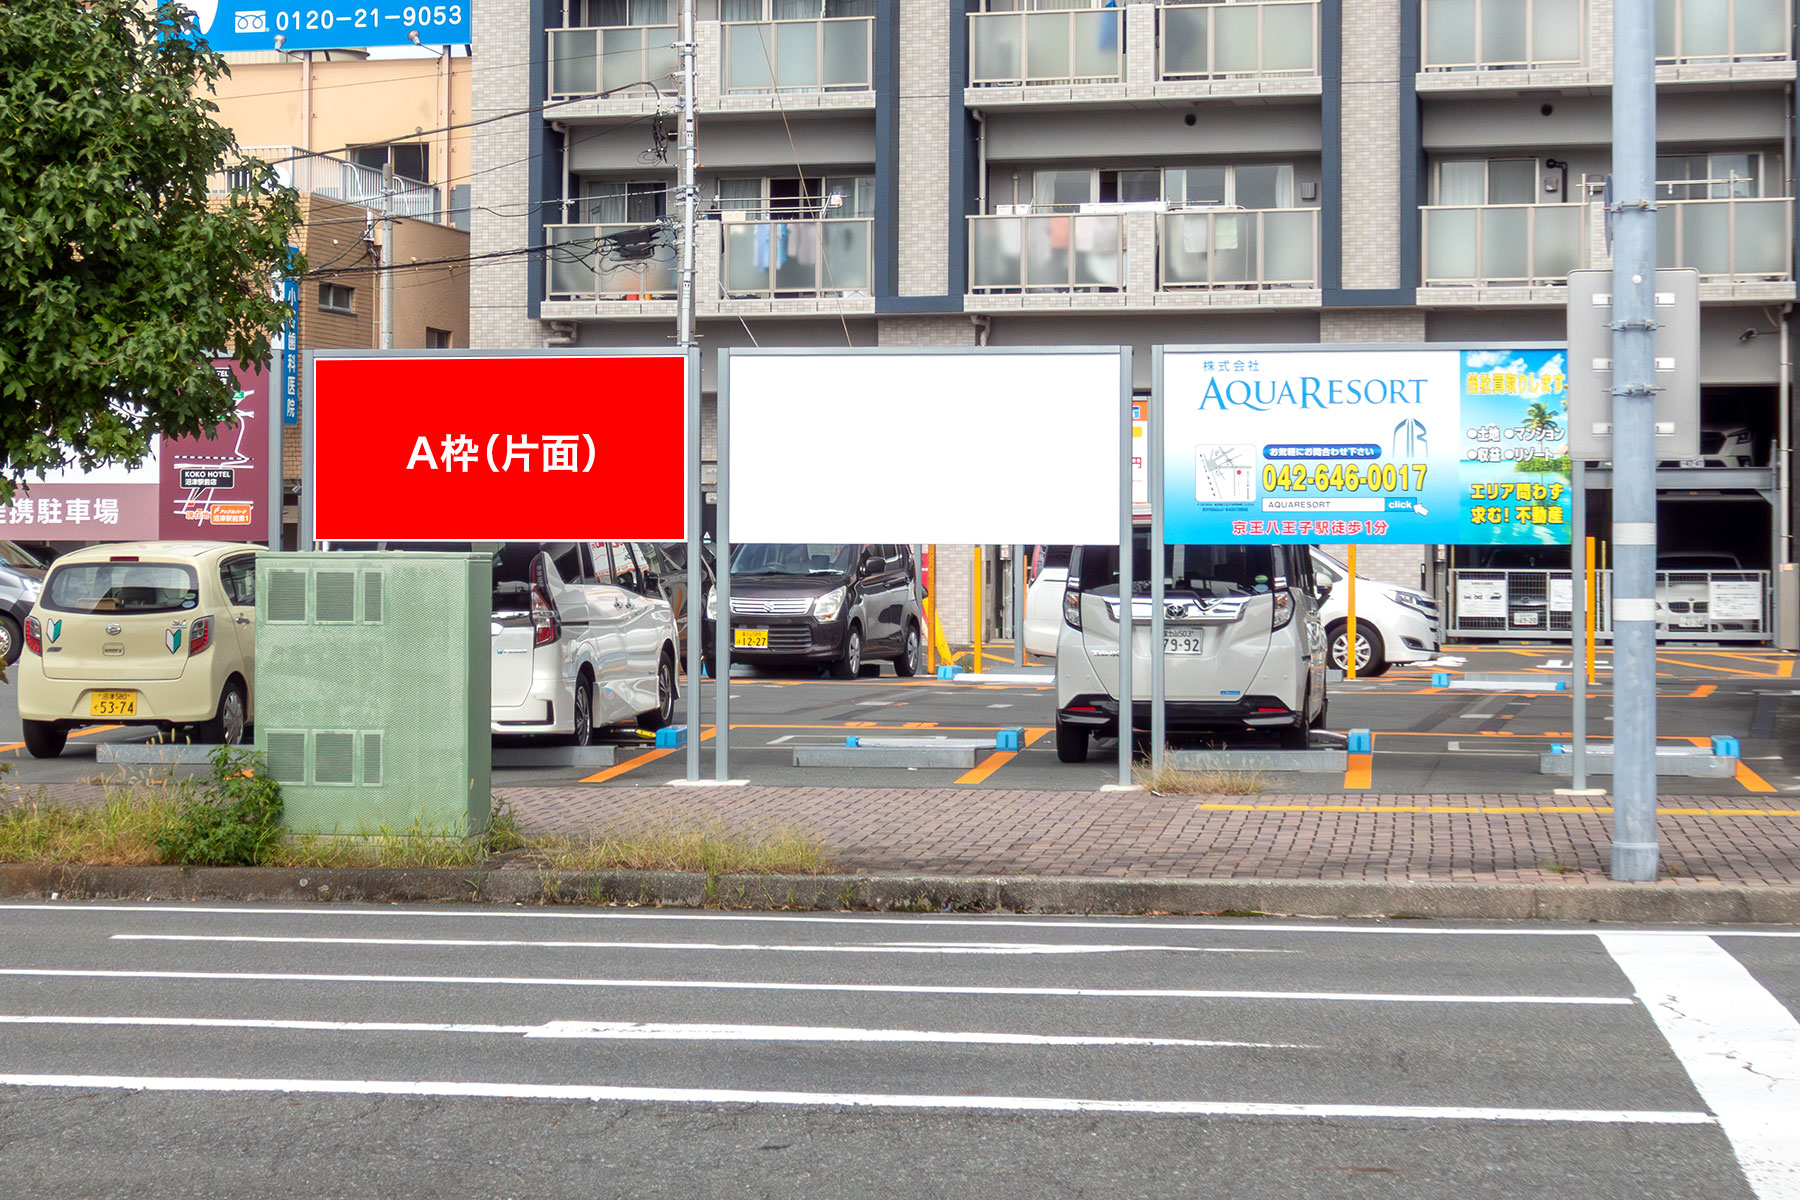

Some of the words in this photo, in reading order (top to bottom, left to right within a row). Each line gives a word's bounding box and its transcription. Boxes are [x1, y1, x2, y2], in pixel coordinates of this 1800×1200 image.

[276, 5, 462, 31] 0120-21-9053
[1203, 360, 1260, 372] 株式会社
[1477, 426, 1500, 442] 土地
[1514, 427, 1565, 441] マンション
[1477, 447, 1501, 463] 収益
[1514, 447, 1554, 461] リゾート
[1262, 463, 1427, 492] 042-646-0017
[1470, 482, 1564, 501] エリア問わず
[0, 498, 119, 525] 携駐車場
[1268, 501, 1331, 509] AQUARESORT
[1388, 500, 1413, 510] click
[1231, 520, 1389, 535] 京王八王子駅徒歩1分
[742, 637, 766, 646] 12-27
[1163, 638, 1199, 652] 79-92
[99, 700, 134, 714] 53-74
